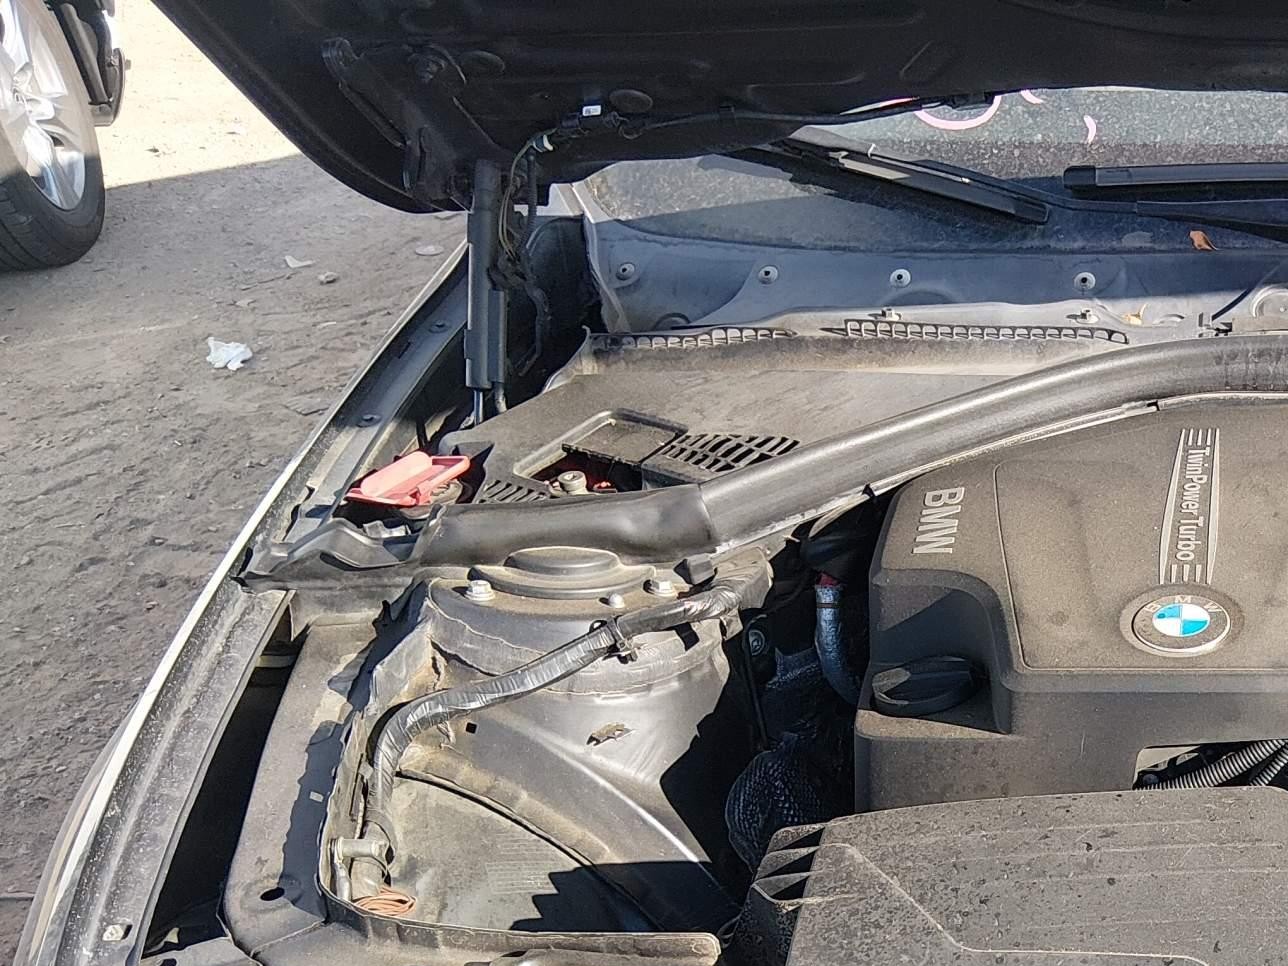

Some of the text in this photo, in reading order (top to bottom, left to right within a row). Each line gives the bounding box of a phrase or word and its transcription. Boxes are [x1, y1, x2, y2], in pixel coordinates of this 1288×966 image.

[912, 487, 965, 554] BMW
[1175, 446, 1210, 562] TwinPower Turbo
[1144, 595, 1222, 612] BMW
